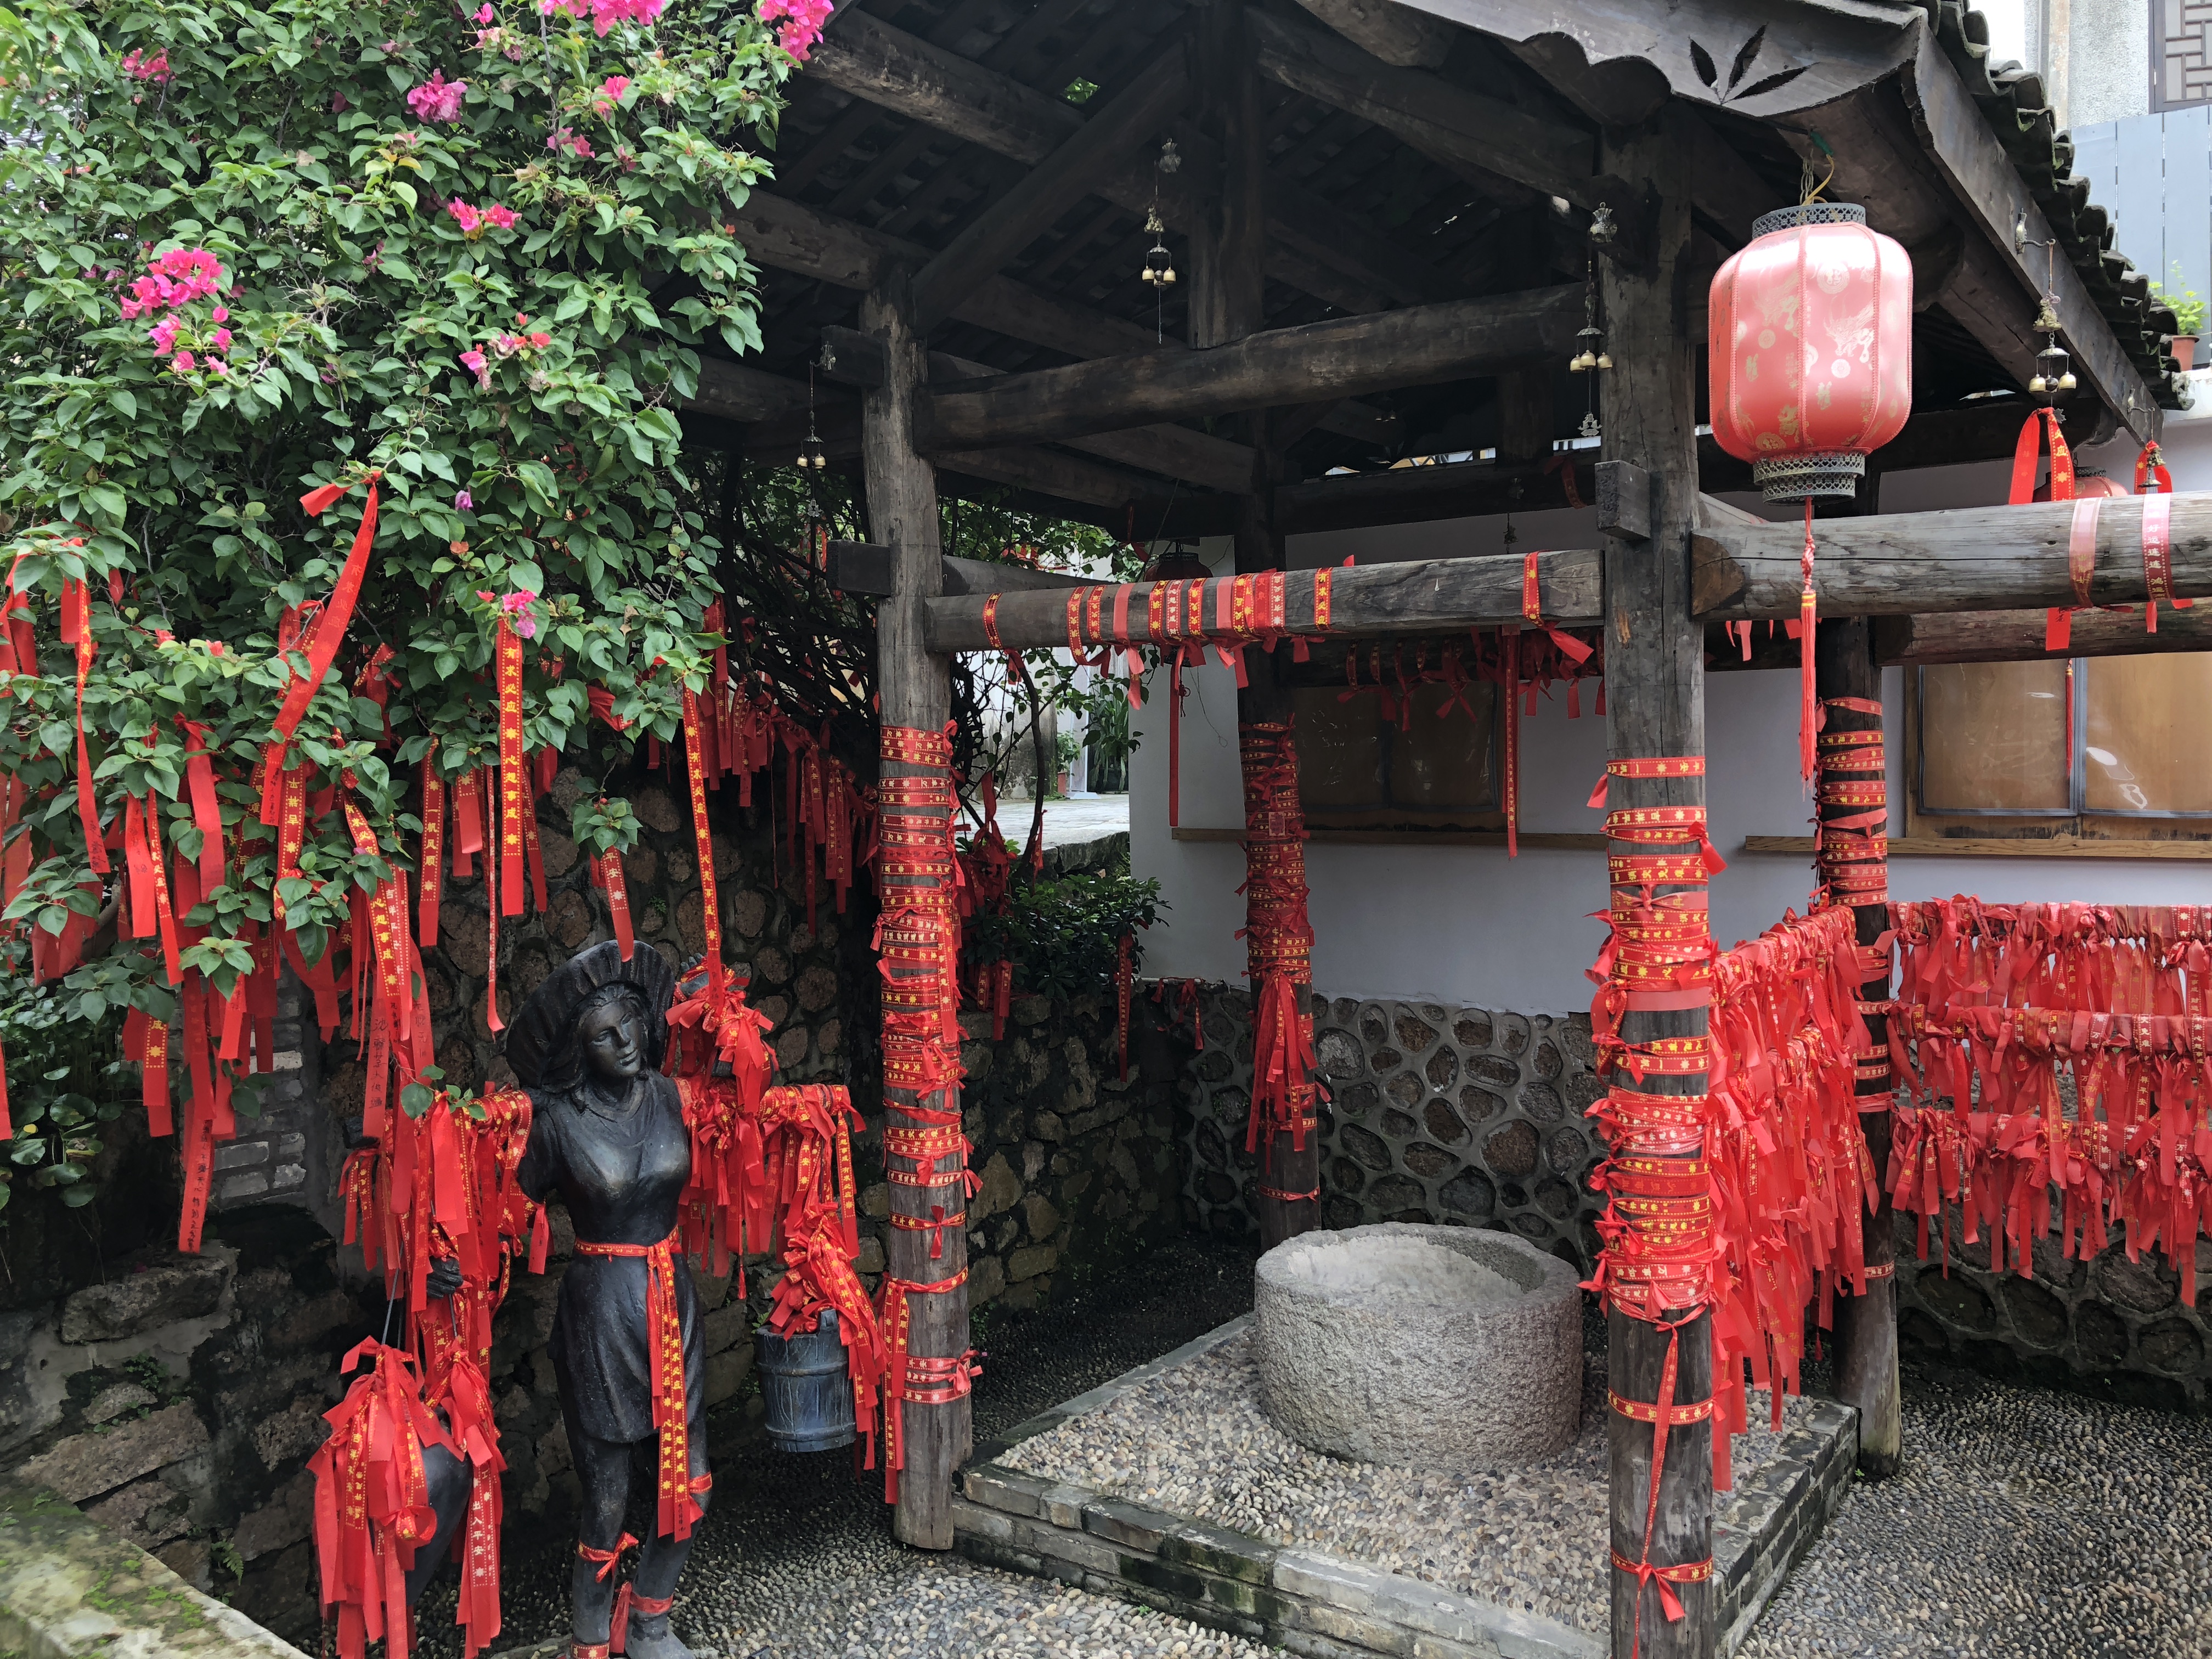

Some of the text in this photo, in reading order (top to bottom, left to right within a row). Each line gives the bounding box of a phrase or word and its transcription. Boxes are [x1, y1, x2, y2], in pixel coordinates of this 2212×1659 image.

[2146, 524, 2162, 569] 好运连连
[1318, 573, 1327, 625] 有求必应
[505, 648, 517, 713] 有求必应
[505, 754, 517, 819] 心想事成
[425, 809, 438, 866] 一帆风顺
[605, 852, 620, 878] 平安
[373, 897, 393, 960] 心想事成
[801, 1144, 810, 1166] 平安
[671, 1339, 682, 1390] 有求必应
[1648, 1407, 1702, 1422] 吉平安
[663, 1418, 672, 1470] 心想事成
[674, 1421, 685, 1474] 心想事成
[472, 1500, 484, 1556] 出入平安
